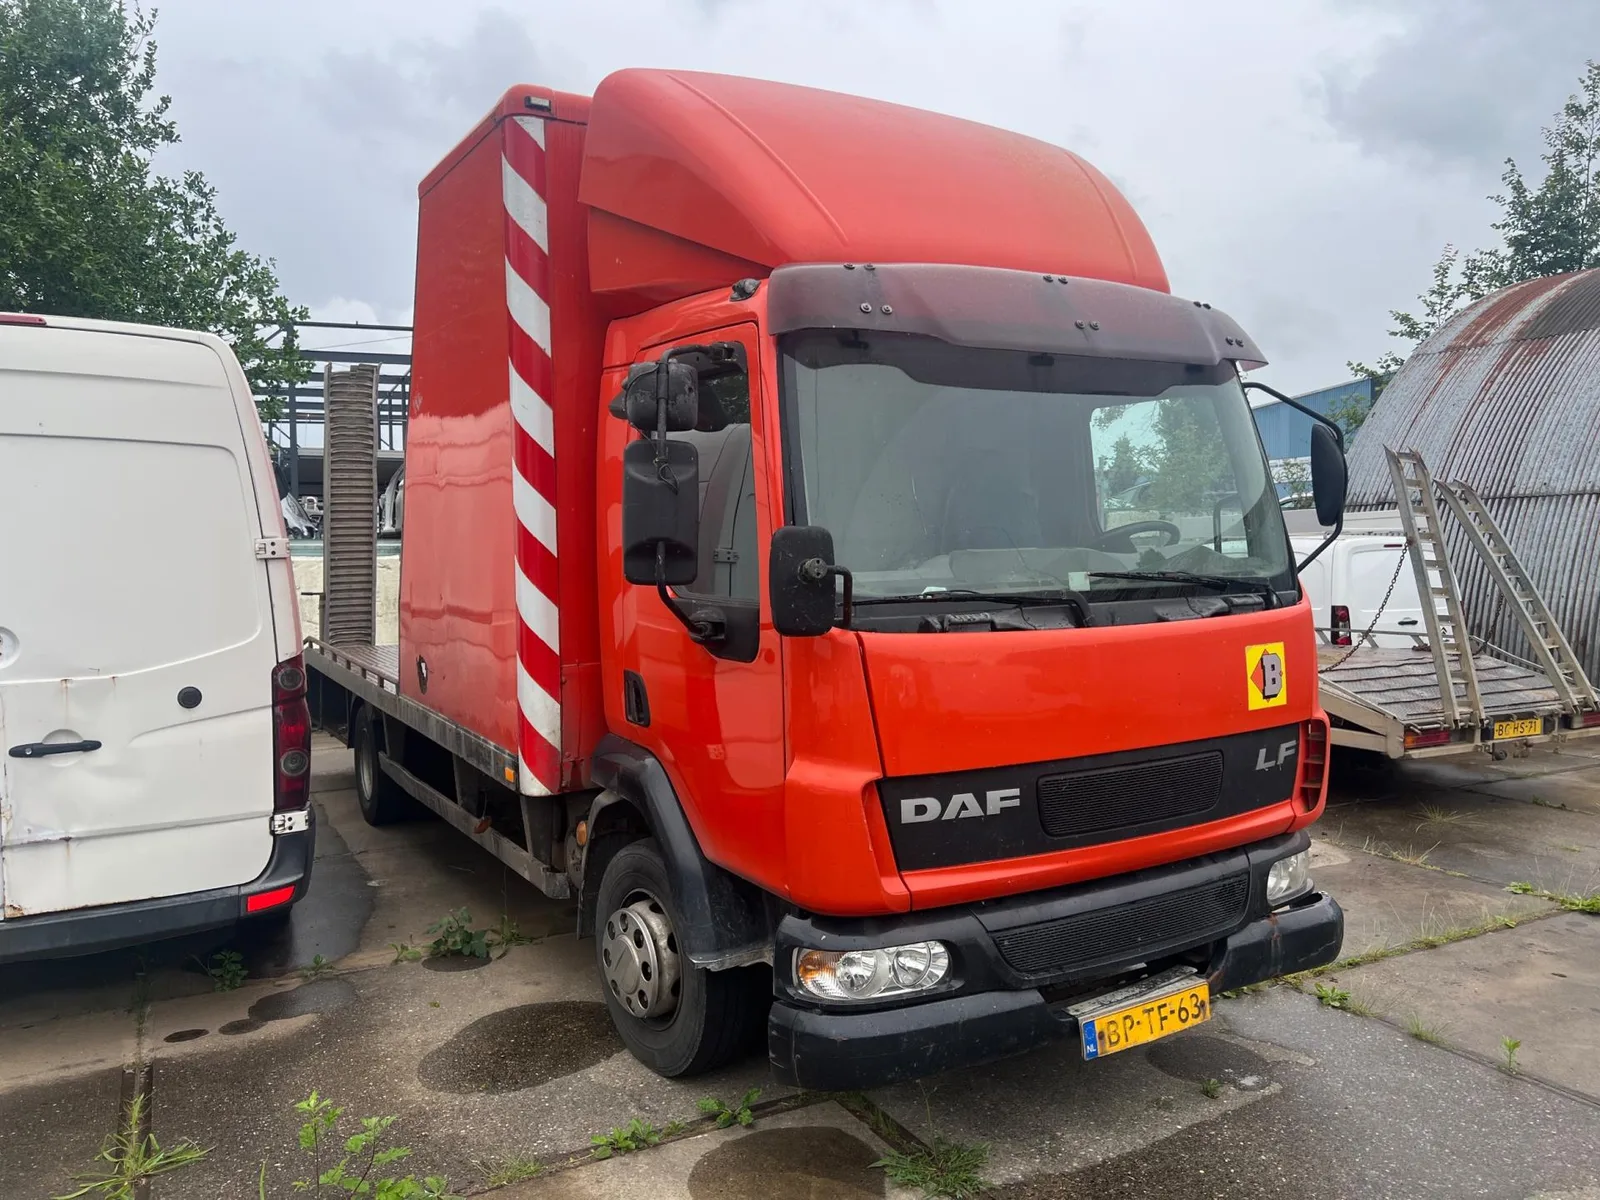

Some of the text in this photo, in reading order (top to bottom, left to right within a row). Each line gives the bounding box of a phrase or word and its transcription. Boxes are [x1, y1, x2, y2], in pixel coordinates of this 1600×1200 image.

[1260, 652, 1283, 699] B
[1256, 740, 1297, 770] LF
[901, 788, 1020, 824] DAF
[1106, 993, 1201, 1048] BP-TF-63
[1086, 1043, 1097, 1053] NL
